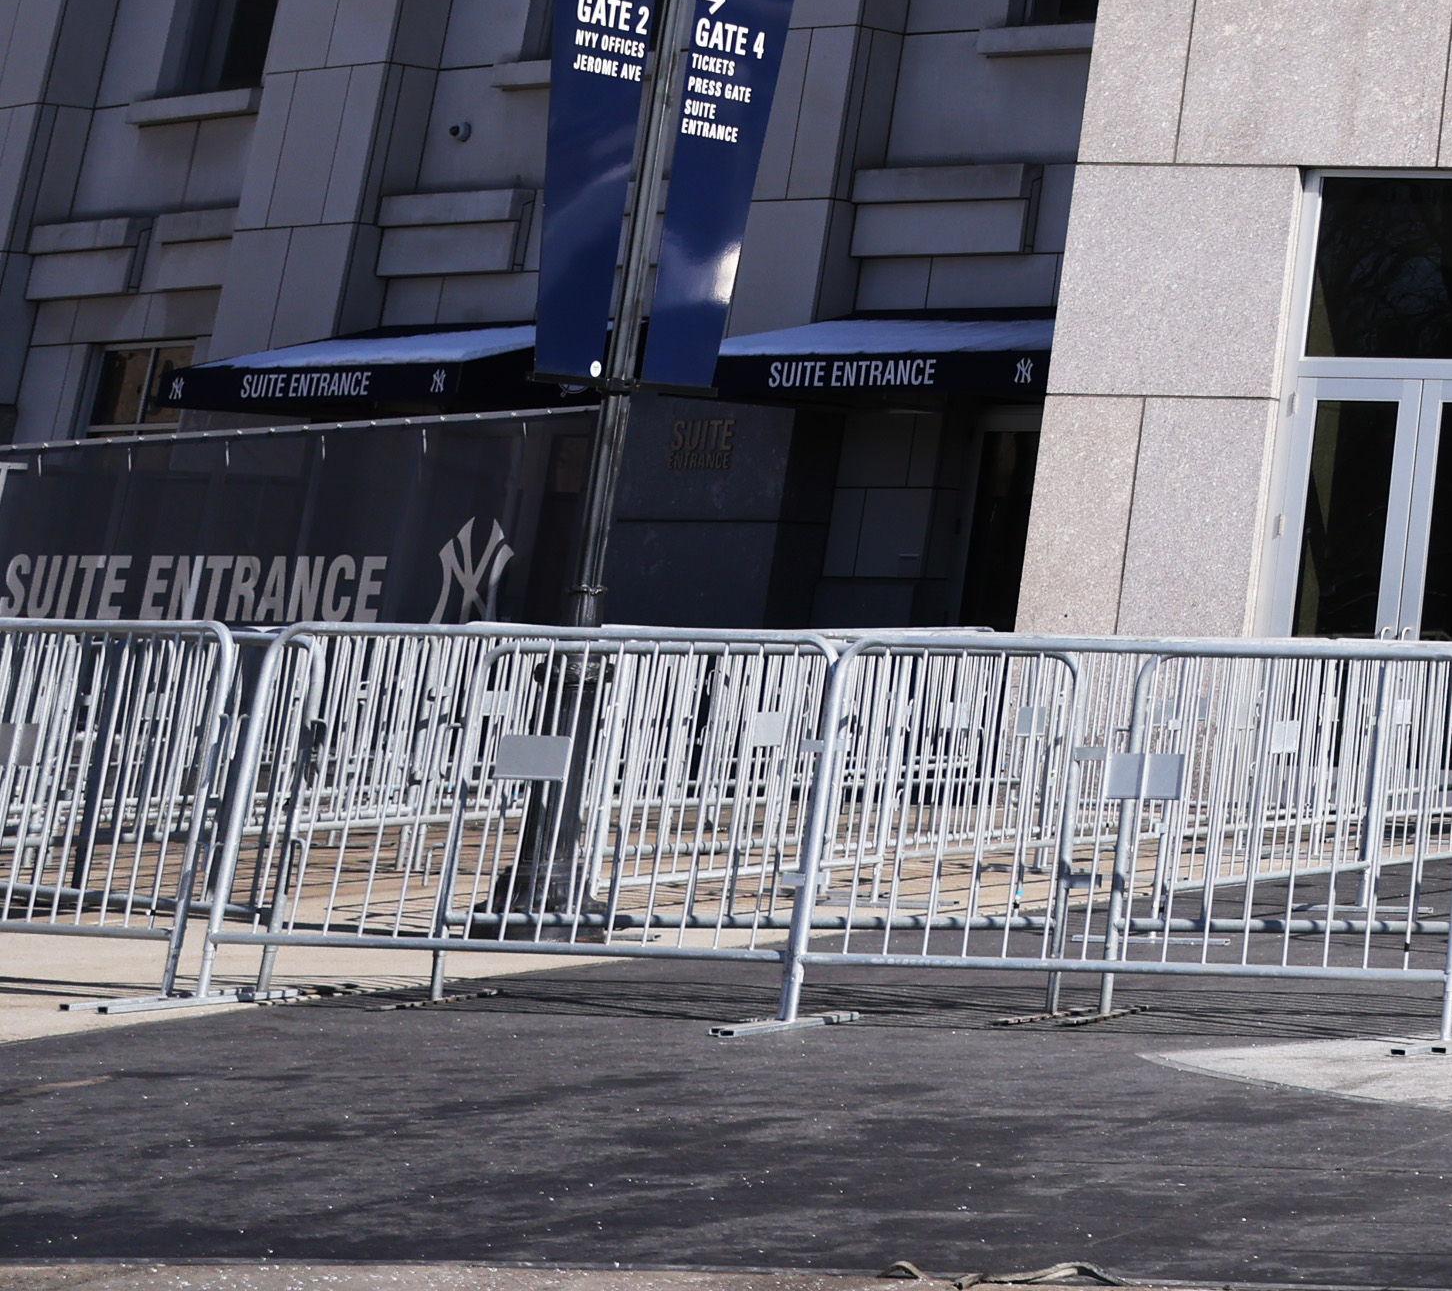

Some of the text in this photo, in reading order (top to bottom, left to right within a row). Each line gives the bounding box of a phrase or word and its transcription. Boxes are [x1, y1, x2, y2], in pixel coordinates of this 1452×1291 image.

[635, 6, 650, 35] 2
[575, 29, 645, 59] NYY OFFICES
[695, 18, 766, 60] GATE 4
[573, 53, 642, 82] JEROME AVE
[692, 53, 736, 77] TICKETS
[688, 76, 752, 104] PRESS GATE
[684, 99, 716, 120] SUITE
[681, 118, 739, 143] ENTRANCE
[240, 373, 286, 399] SUITE
[288, 371, 371, 398] ENTRANCE
[768, 361, 826, 388] SUITE
[830, 359, 937, 387] ENTRANCE
[671, 419, 736, 452] SUITE
[667, 452, 731, 470] ENTRANCE
[0, 553, 132, 620] SUITE
[138, 553, 388, 623] ENTRANCE
